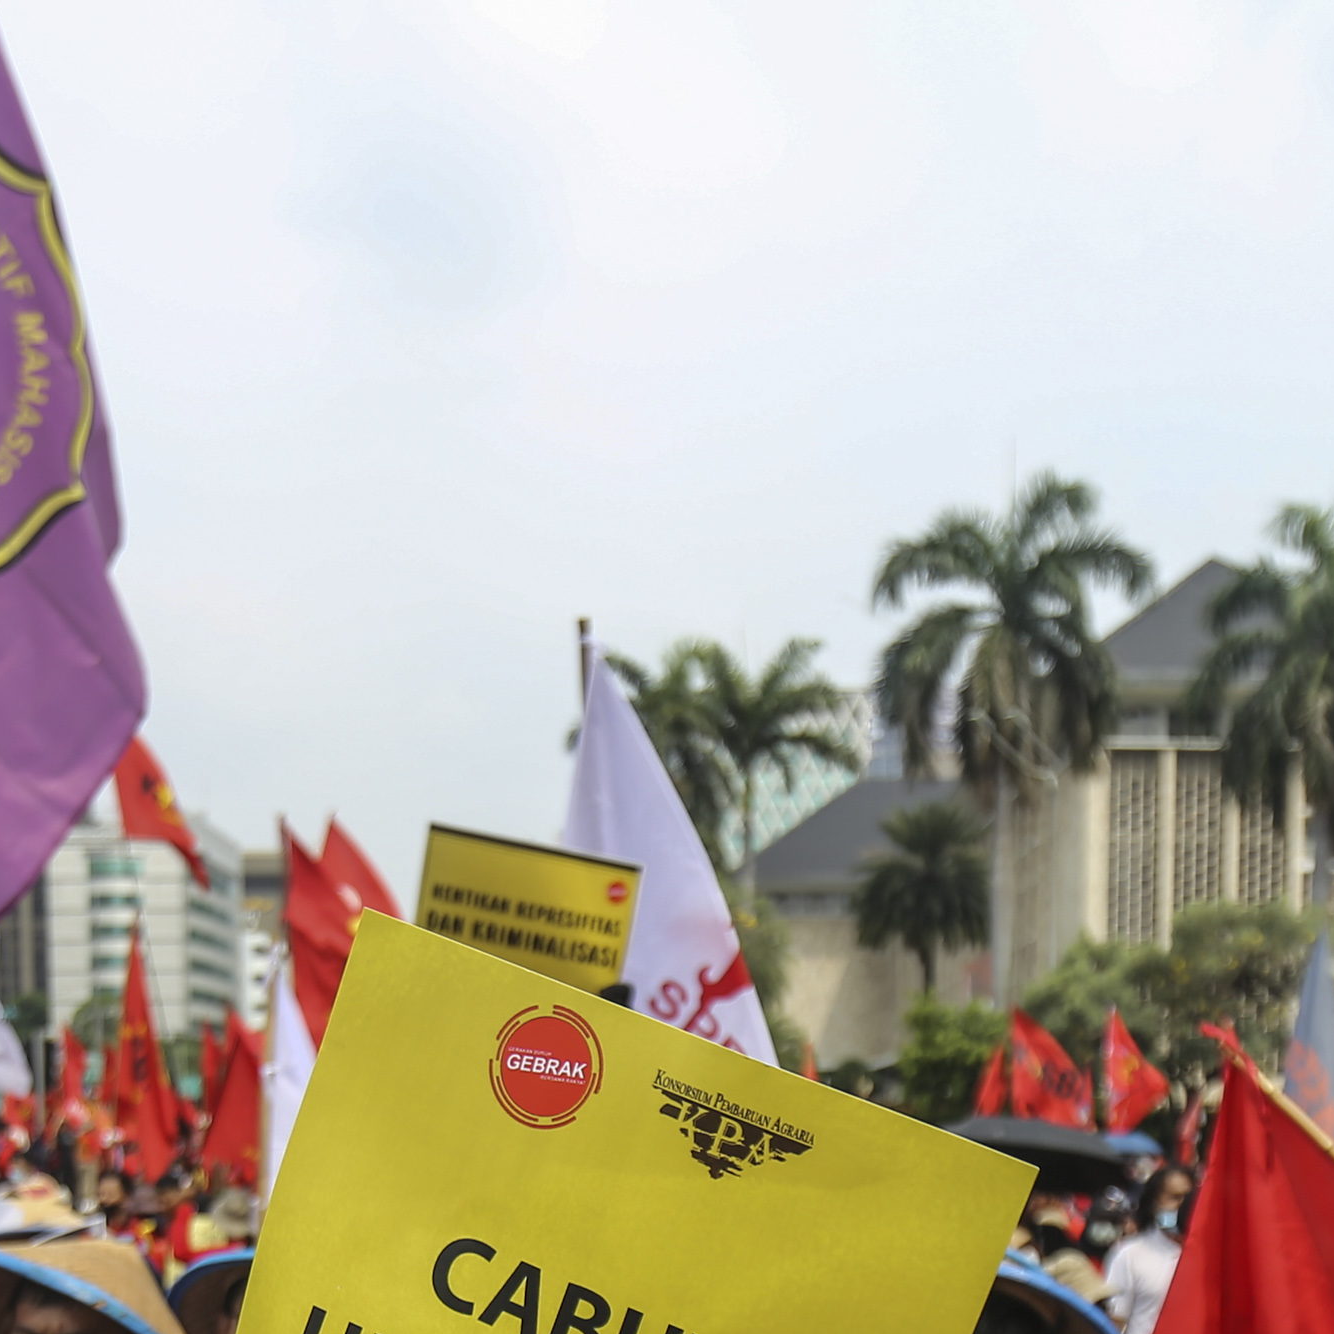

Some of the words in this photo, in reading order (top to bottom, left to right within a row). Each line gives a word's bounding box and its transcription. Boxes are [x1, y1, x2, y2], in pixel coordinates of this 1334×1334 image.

[432, 883, 511, 914] HENTIKAN
[516, 901, 621, 937] REPRESIFITAS
[427, 910, 465, 936] DAN
[472, 921, 618, 969] KRIMINALISASI
[507, 1053, 587, 1079] GEBRAK
[676, 1100, 773, 1165] KPA
